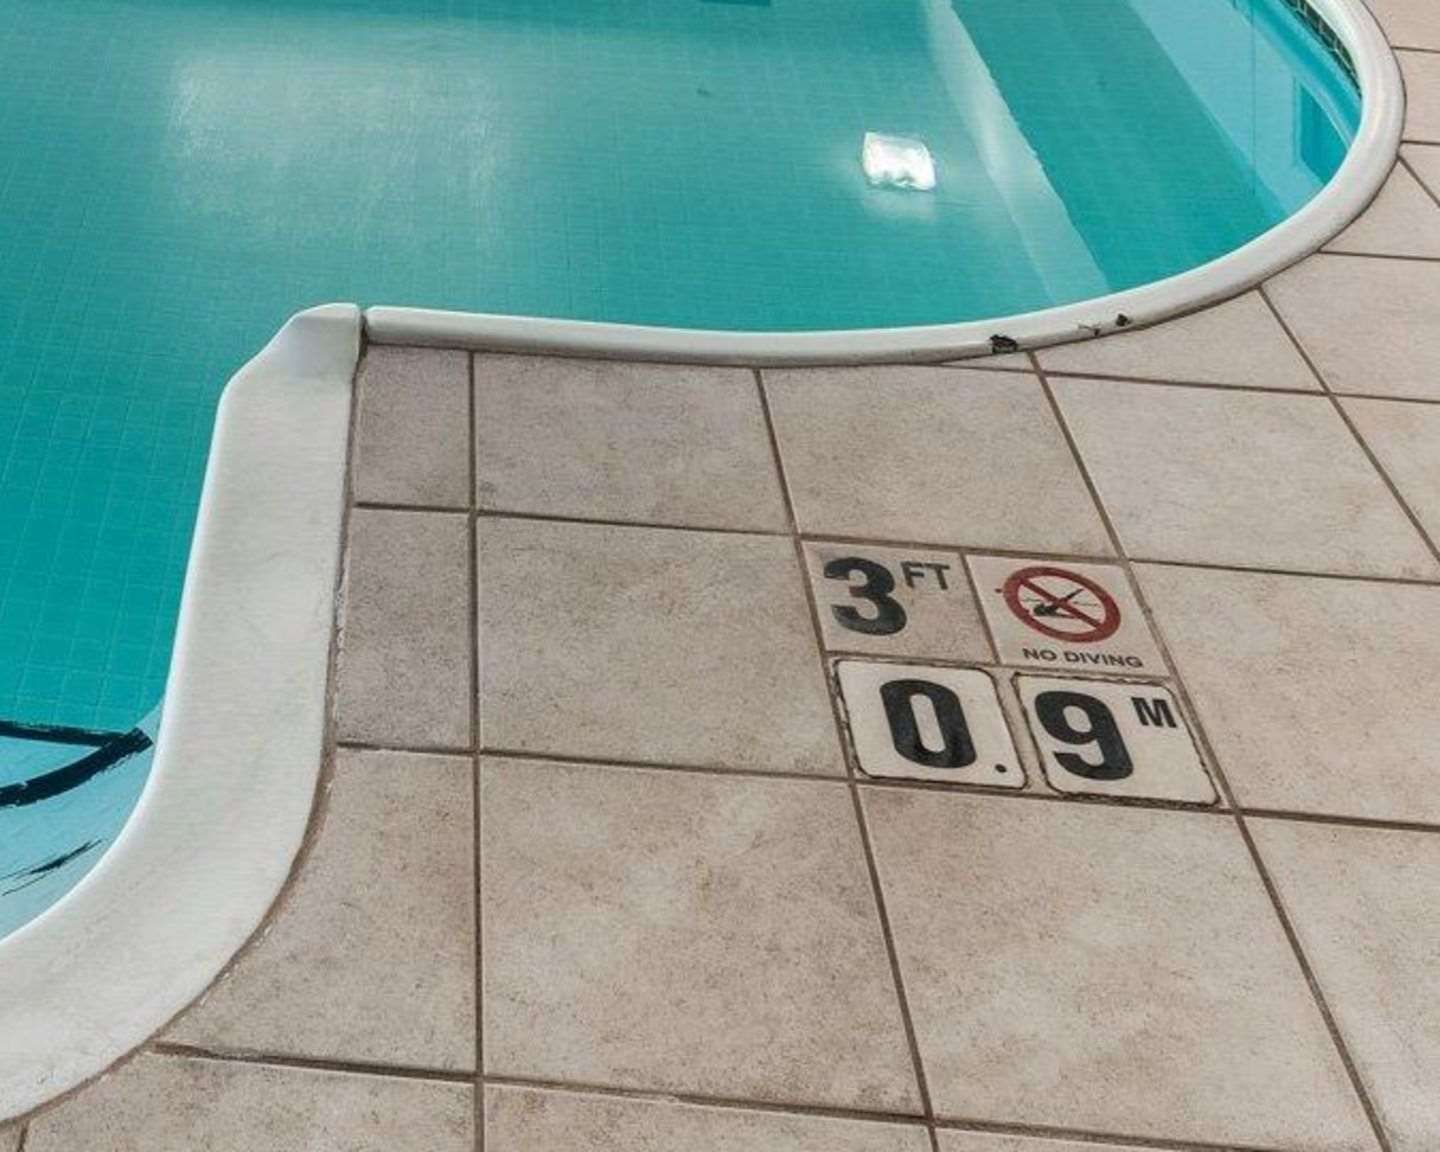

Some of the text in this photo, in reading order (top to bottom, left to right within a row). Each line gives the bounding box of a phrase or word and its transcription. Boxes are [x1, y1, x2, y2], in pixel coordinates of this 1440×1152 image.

[824, 556, 952, 636] 3 FT
[1023, 647, 1144, 669] NO DIVING
